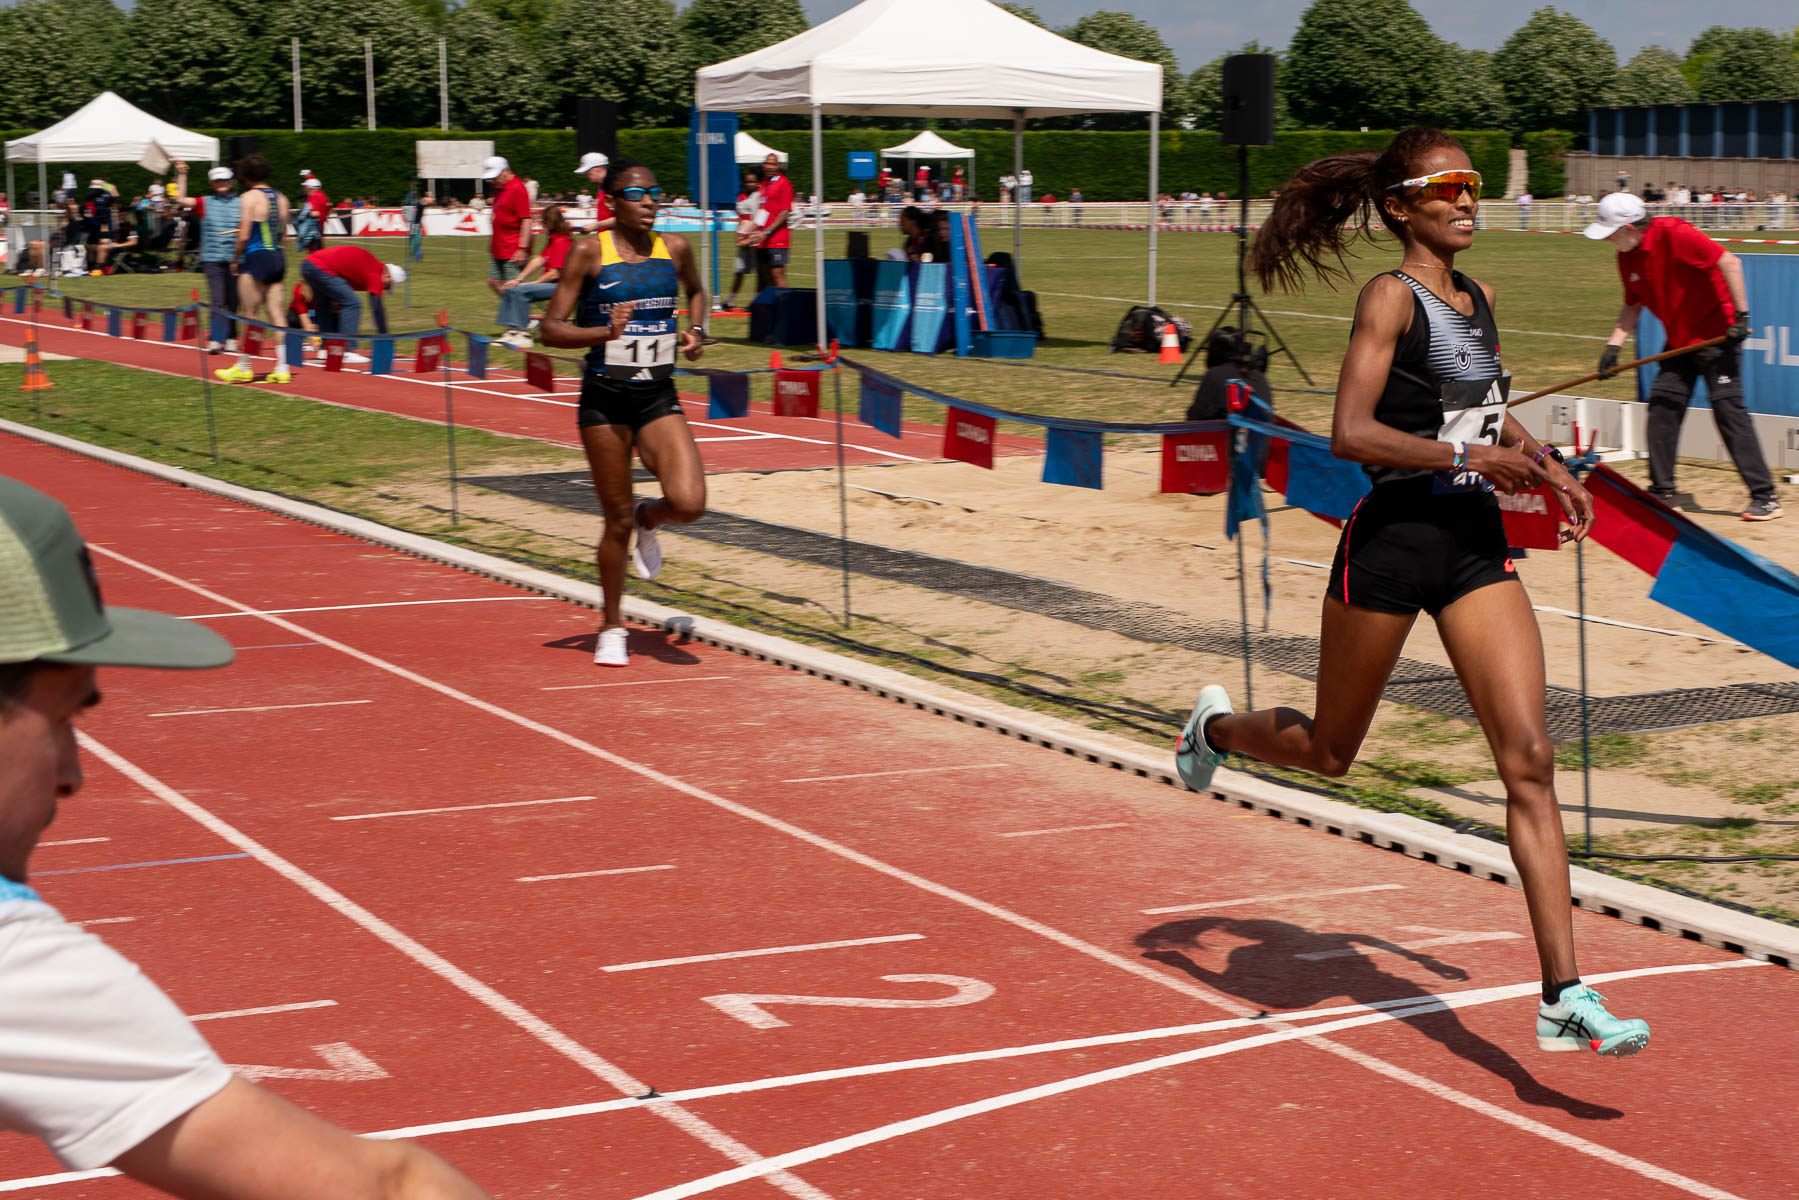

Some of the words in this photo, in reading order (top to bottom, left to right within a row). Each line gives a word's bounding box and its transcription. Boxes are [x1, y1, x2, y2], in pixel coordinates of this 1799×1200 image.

[624, 339, 659, 363] 11
[1478, 413, 1499, 446] 5
[1176, 444, 1219, 462] DIMA
[702, 973, 997, 1030] 2
